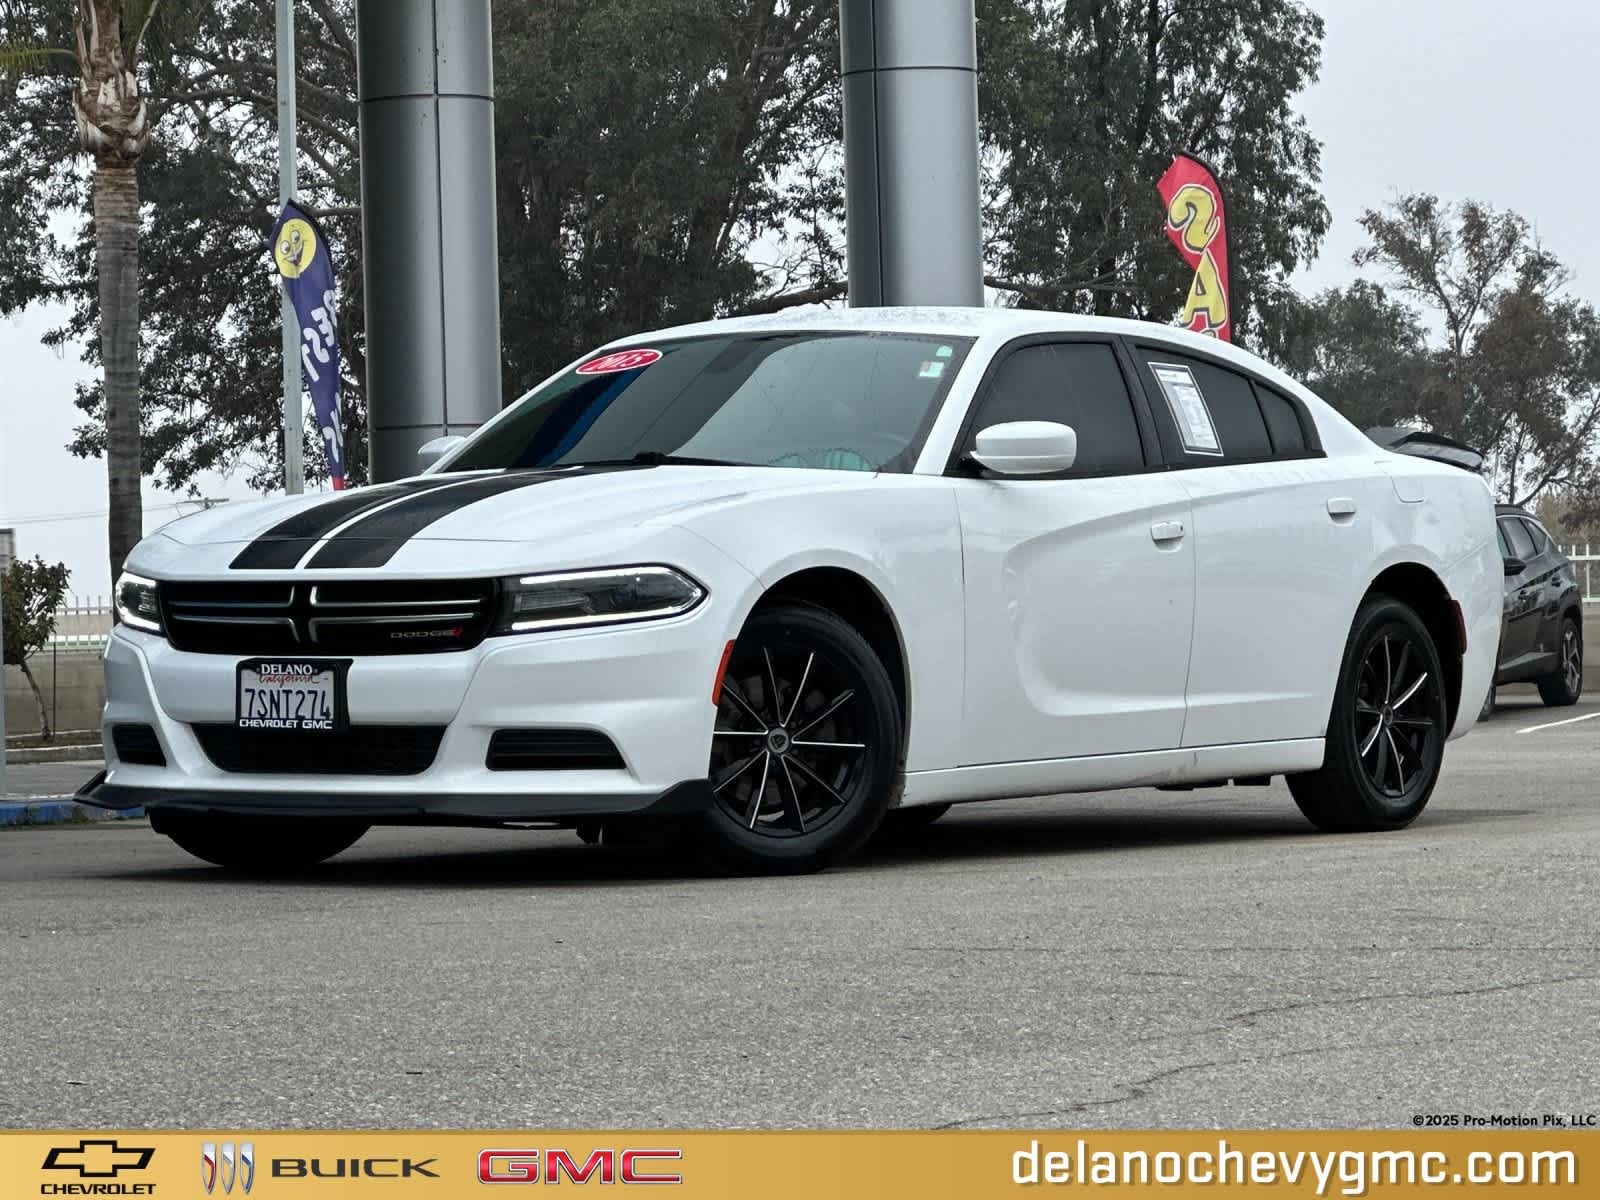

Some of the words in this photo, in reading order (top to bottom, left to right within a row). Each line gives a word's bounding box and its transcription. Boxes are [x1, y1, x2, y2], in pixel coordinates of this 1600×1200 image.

[390, 630, 457, 639] DODGE
[261, 663, 313, 675] DELANO
[244, 687, 332, 720] 7SNT274
[239, 719, 299, 728] CHEVROLET
[302, 720, 333, 729] GMC
